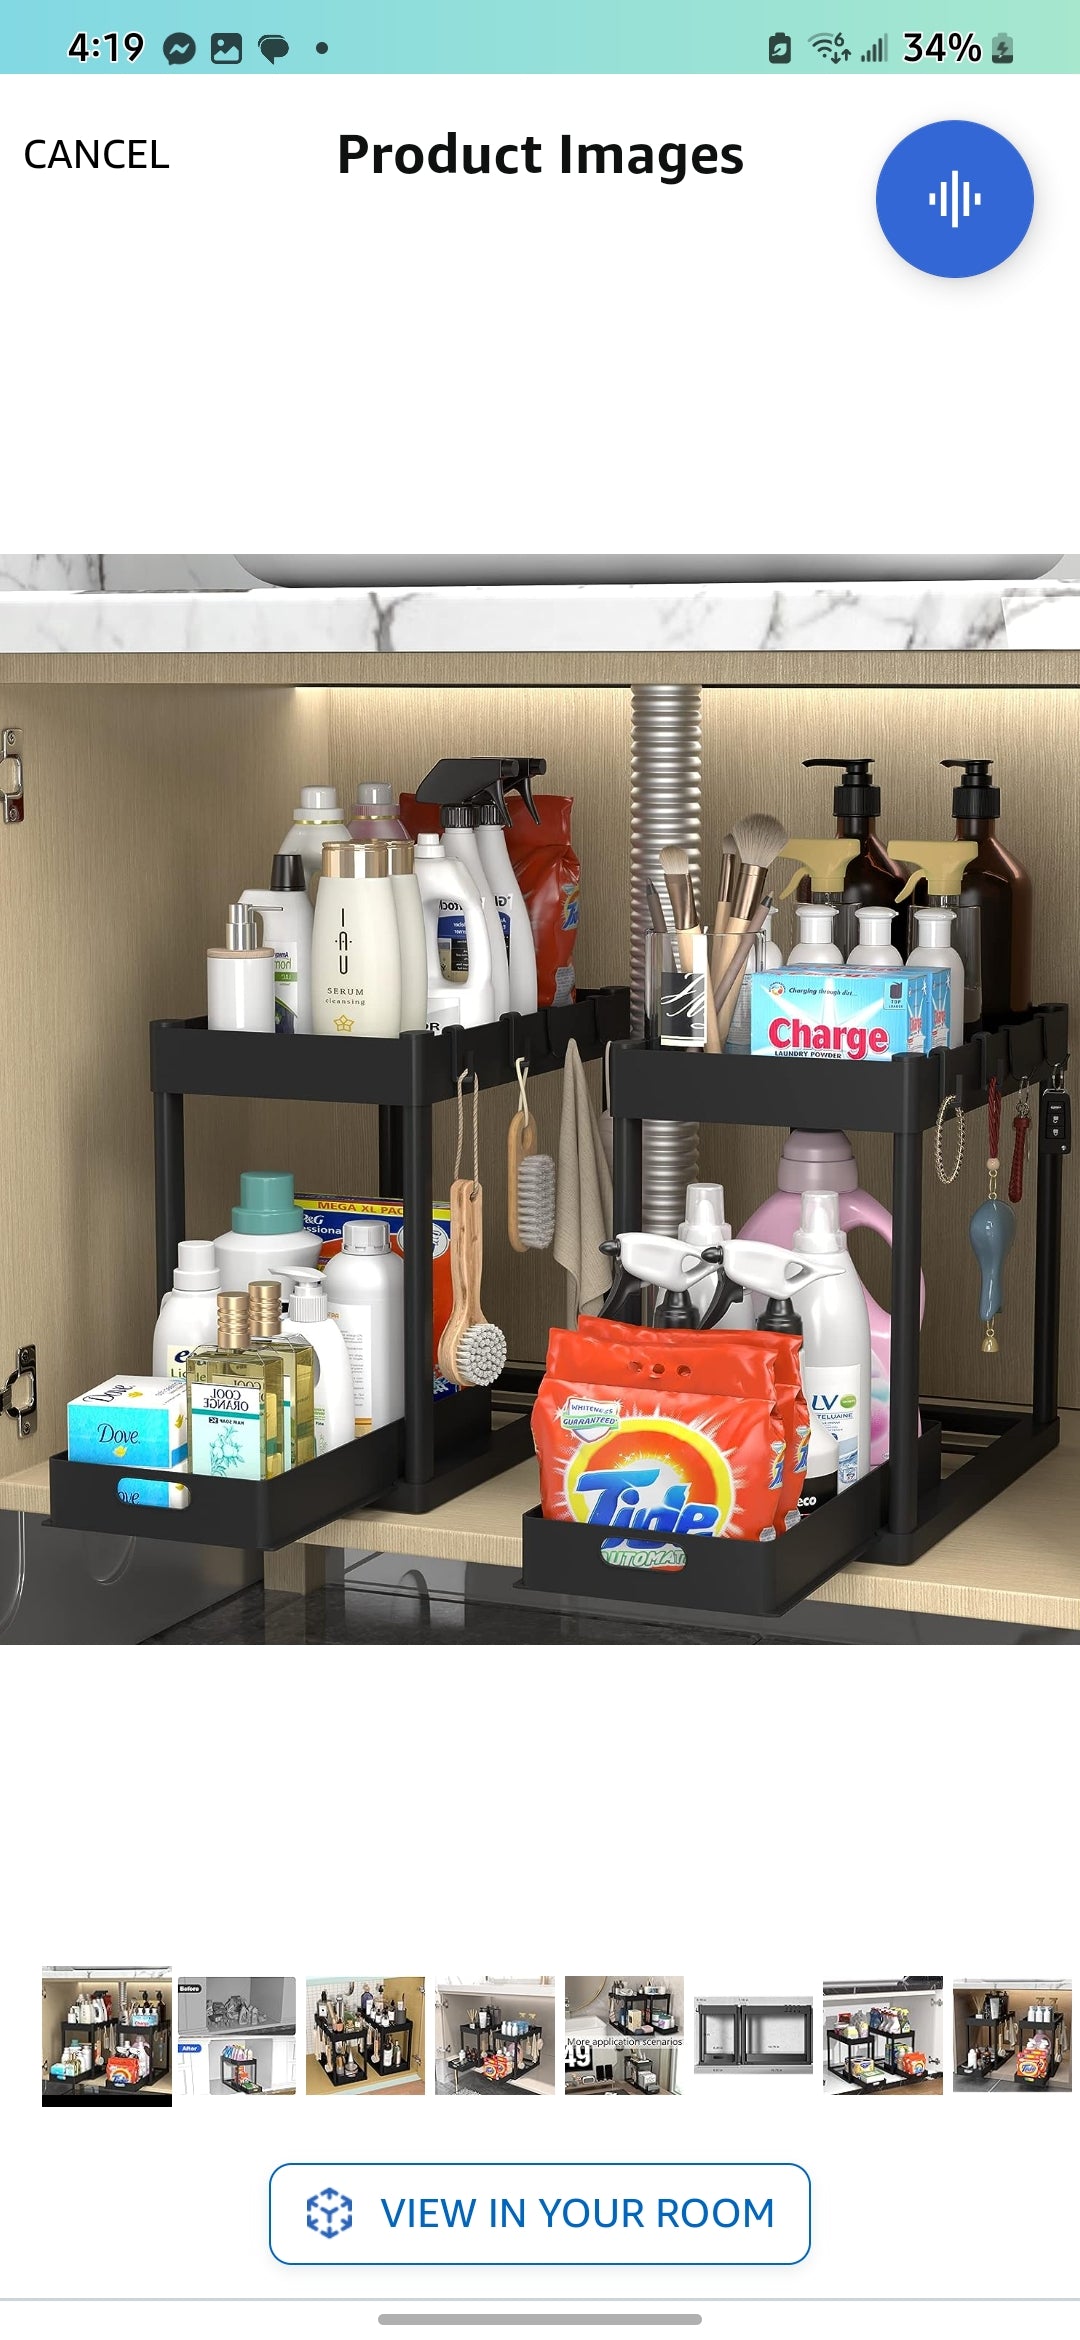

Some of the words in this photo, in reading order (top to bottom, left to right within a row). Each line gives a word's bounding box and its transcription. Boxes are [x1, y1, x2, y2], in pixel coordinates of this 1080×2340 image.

[68, 32, 144, 62] 4:19
[903, 32, 983, 62] 34%
[24, 139, 170, 169] CANCEL
[339, 131, 542, 175] Product
[561, 134, 744, 185] Images
[327, 987, 365, 996] SERUM
[788, 987, 818, 996] Charging
[818, 988, 841, 997] through
[325, 998, 366, 1006] cleansing
[768, 1017, 890, 1060] Charge
[774, 1050, 808, 1058] LAUNDRY
[810, 1051, 842, 1059] POWDER
[317, 1201, 357, 1212] MEGA
[361, 1204, 377, 1214] XL
[380, 1205, 404, 1216] PAC
[303, 1225, 342, 1235] ssiona
[571, 1404, 614, 1415] WHITENESS
[811, 1394, 839, 1411] LV
[97, 1422, 140, 1444] Dove
[118, 1490, 140, 1504] ove
[575, 1467, 720, 1540] Tide
[380, 2198, 477, 2228] VIEW
[490, 2198, 525, 2228] IN
[538, 2198, 645, 2228] YOUR
[658, 2198, 773, 2228] ROOM
